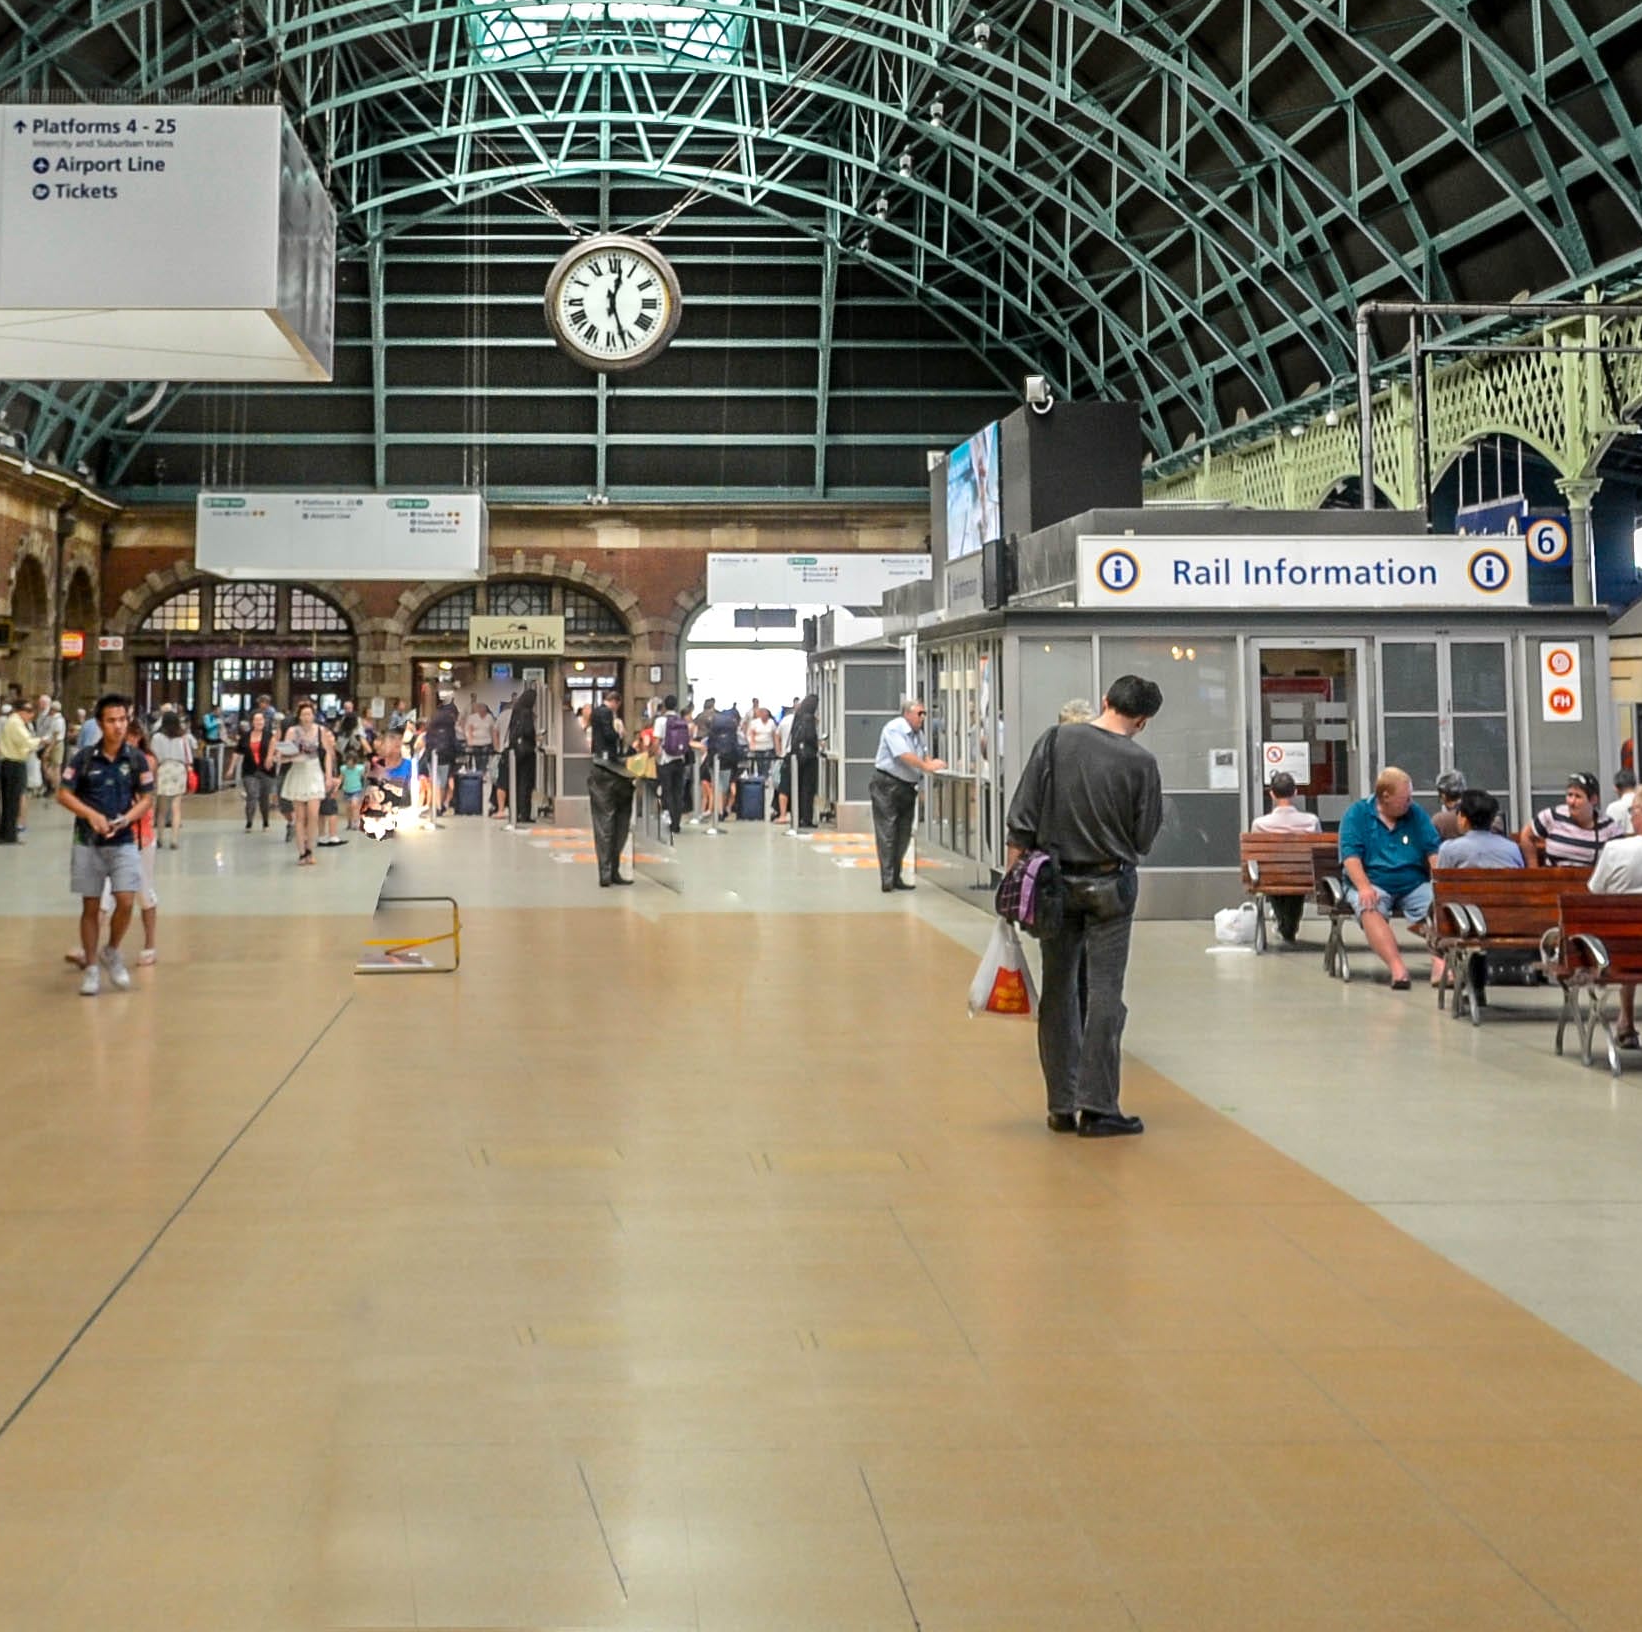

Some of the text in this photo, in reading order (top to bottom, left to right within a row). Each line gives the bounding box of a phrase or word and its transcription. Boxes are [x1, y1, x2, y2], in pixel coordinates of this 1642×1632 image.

[32, 118, 121, 134] Platforms
[126, 119, 137, 134] 4
[154, 119, 177, 134] 25
[55, 156, 165, 175] Airport Line
[55, 183, 118, 199] Tickets
[1538, 526, 1555, 555] 6
[1173, 558, 1230, 585] Rail
[1244, 558, 1437, 585] Information
[477, 635, 557, 650] NewsLink
[1553, 694, 1571, 707] FH
